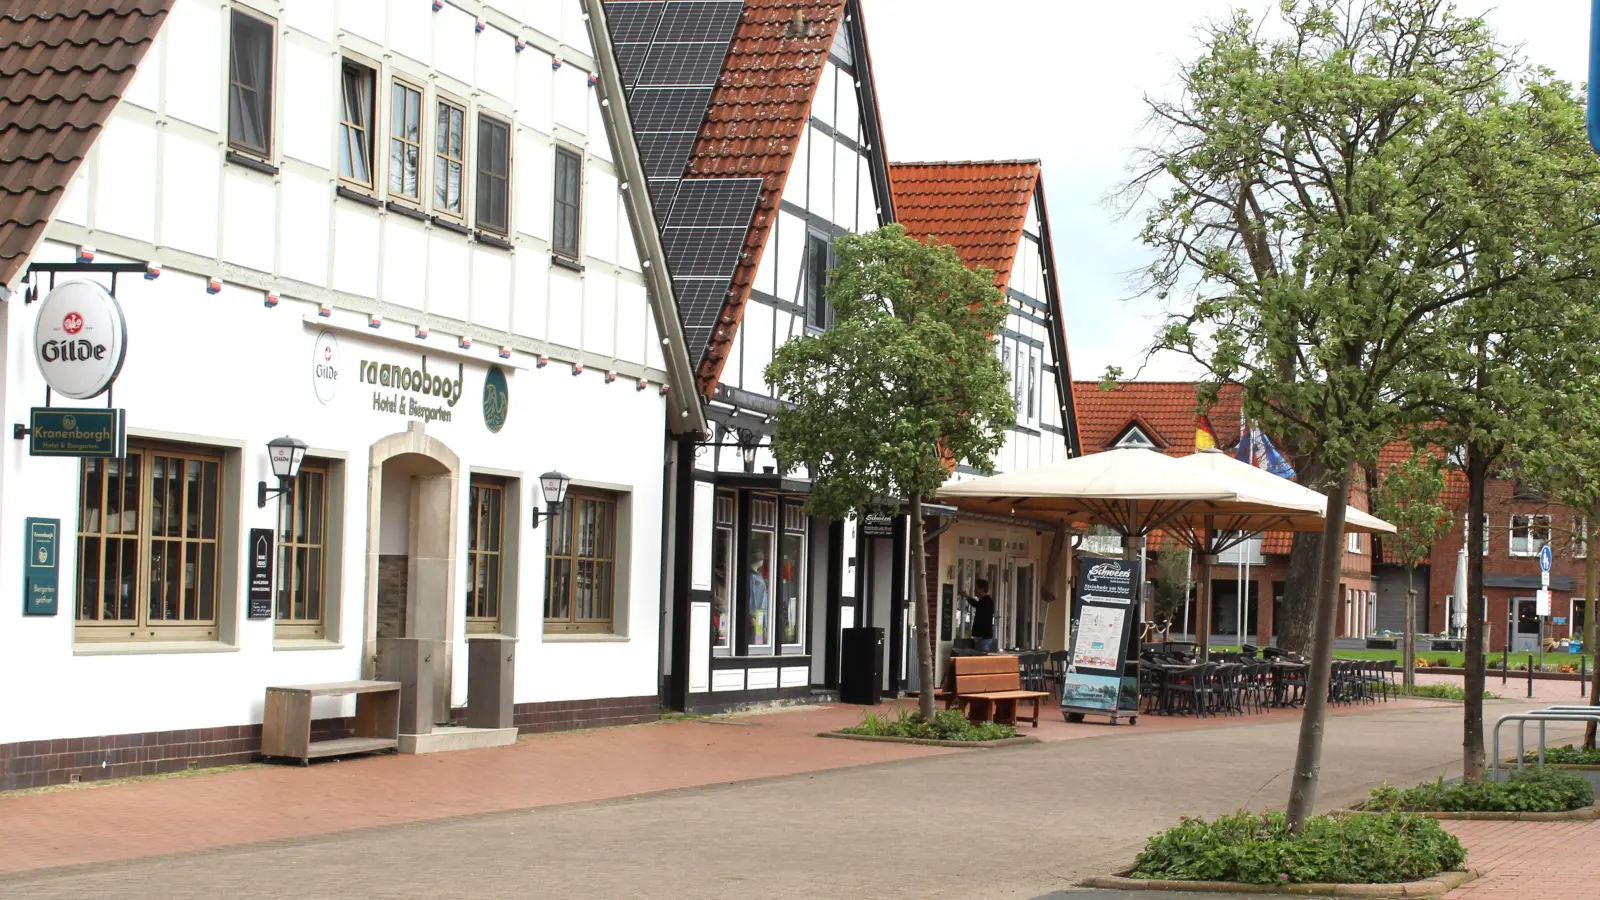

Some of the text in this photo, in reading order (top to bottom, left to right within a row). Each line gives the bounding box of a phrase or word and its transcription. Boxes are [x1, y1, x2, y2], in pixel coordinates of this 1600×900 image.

[41, 339, 107, 362] Gilde
[315, 364, 338, 381] Gilde
[372, 391, 452, 423] Hotel & Biergarten
[34, 425, 110, 442] Kranenborgh
